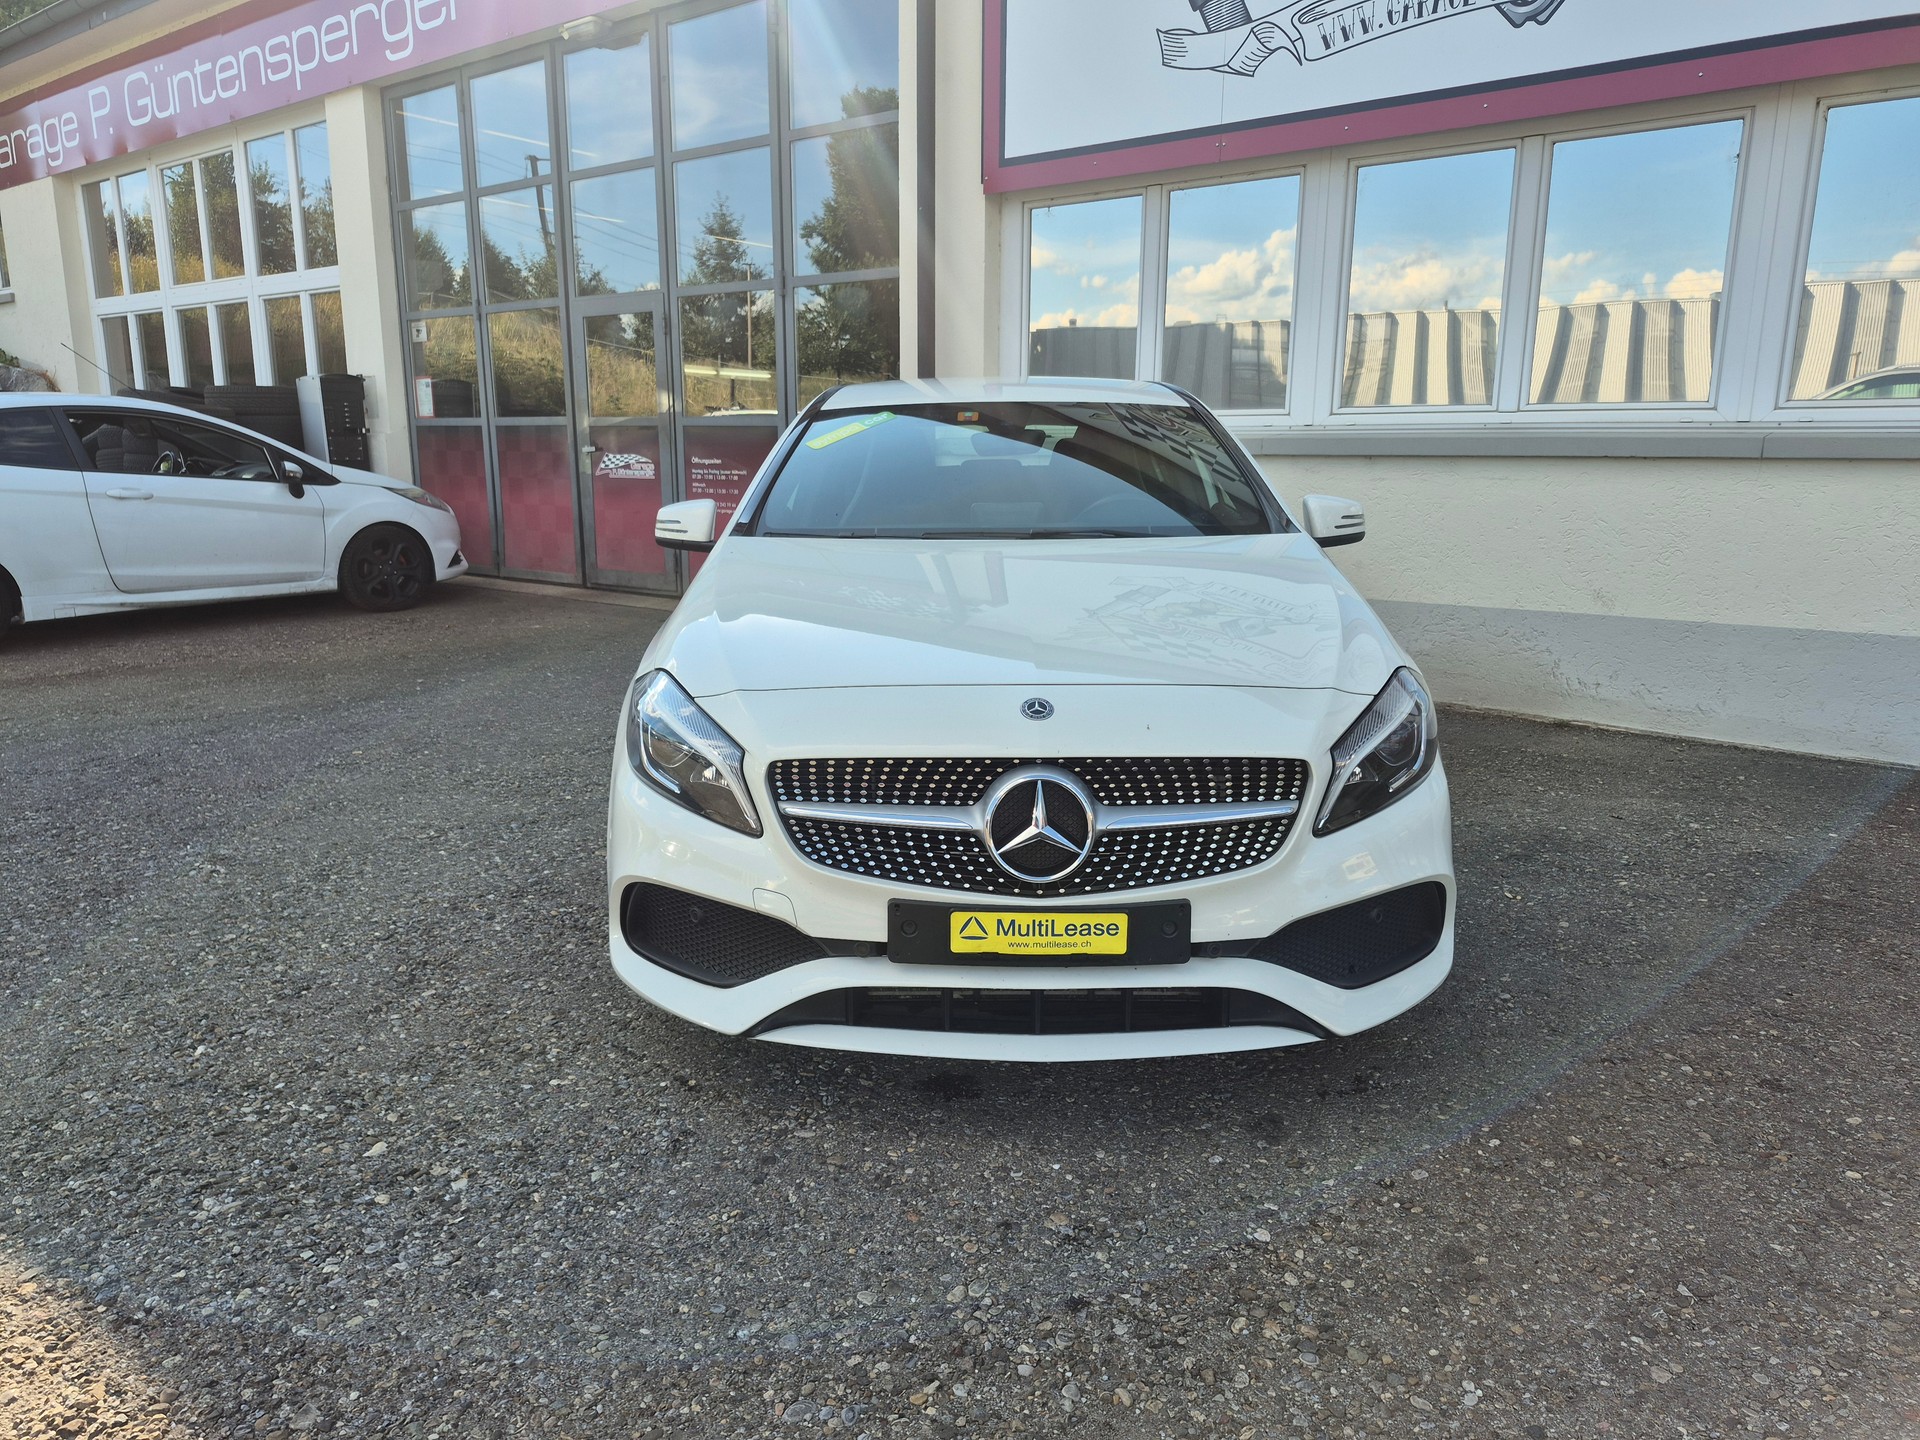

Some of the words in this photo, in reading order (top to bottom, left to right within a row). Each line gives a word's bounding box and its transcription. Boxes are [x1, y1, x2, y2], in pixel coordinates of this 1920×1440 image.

[1317, 0, 1476, 51] WWW.GARA
[88, 86, 113, 139] P.
[996, 919, 1120, 937] MultiLease
[1008, 940, 1092, 949] www.multilease.ch
